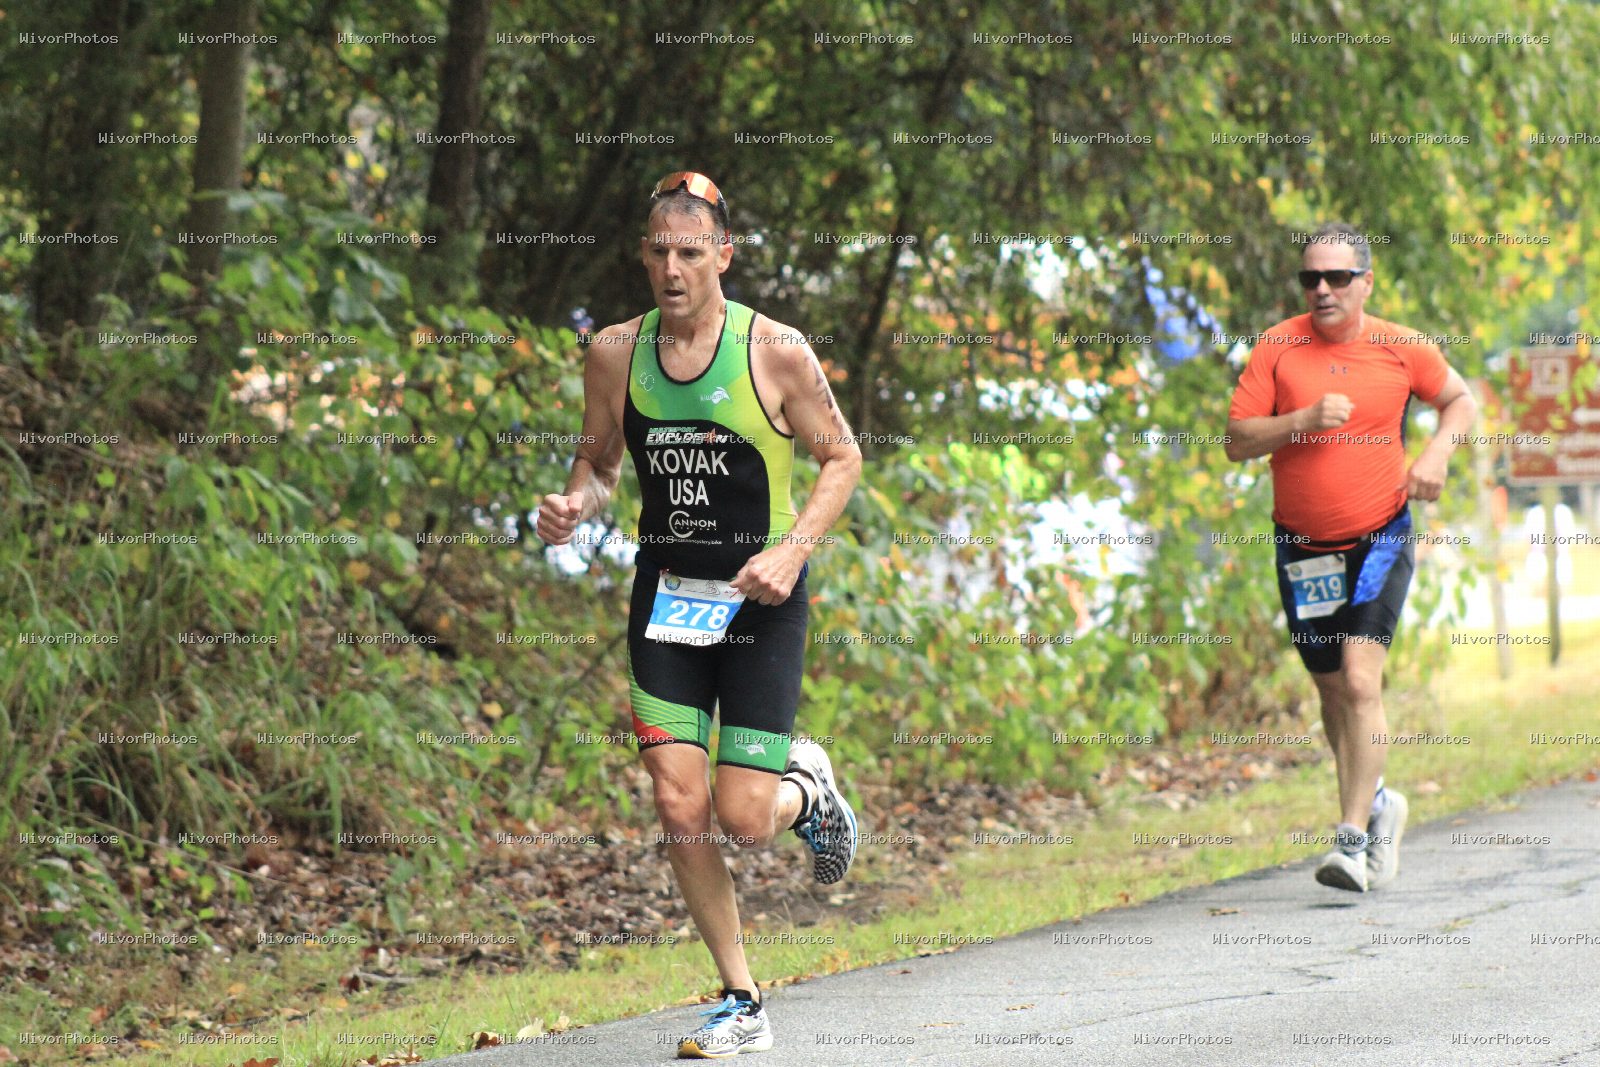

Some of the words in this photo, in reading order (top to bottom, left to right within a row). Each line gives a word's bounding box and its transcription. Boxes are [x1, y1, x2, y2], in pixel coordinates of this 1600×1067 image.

[646, 448, 730, 476] KOVAK
[669, 478, 710, 506] USA
[1302, 575, 1342, 602] 219
[666, 600, 730, 630] 278
